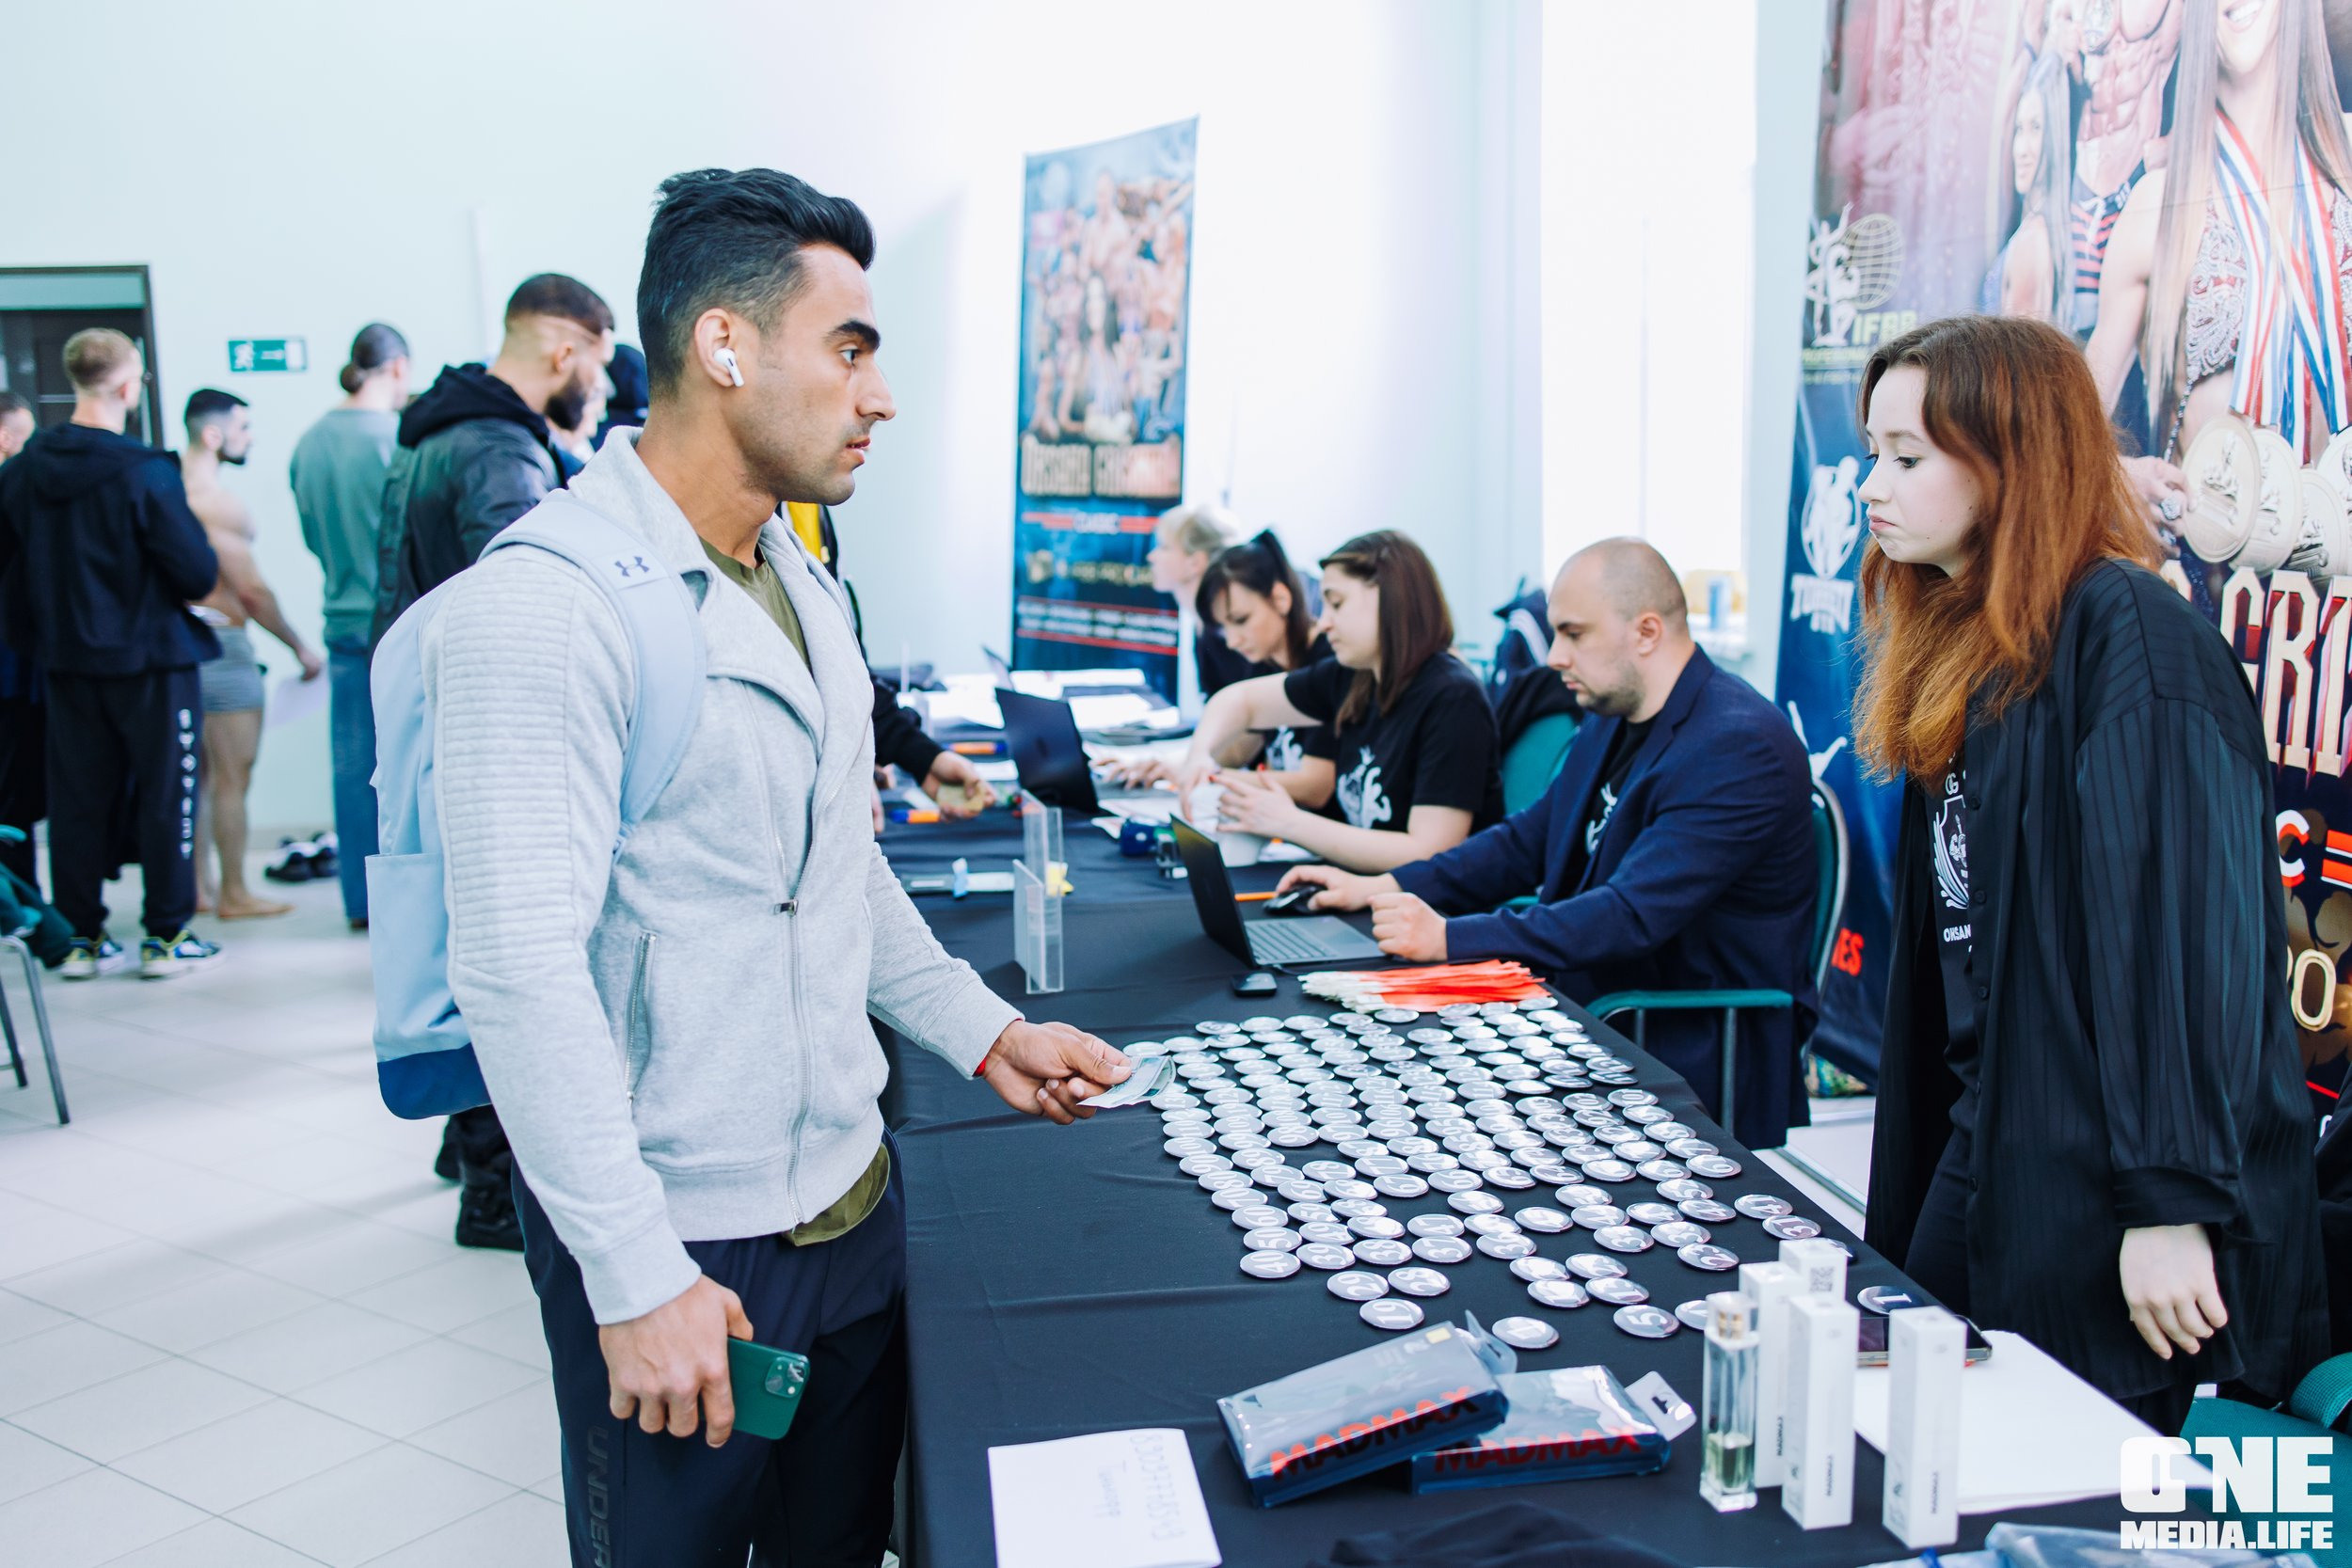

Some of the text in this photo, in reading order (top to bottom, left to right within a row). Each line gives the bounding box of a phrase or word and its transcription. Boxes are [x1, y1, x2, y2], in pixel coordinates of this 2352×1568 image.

[1379, 1103, 1403, 1120] 106
[1174, 1120, 1201, 1137] 110
[1226, 1116, 1252, 1132] 109
[1327, 1124, 1365, 1141] 97
[1380, 1120, 1411, 1137] 96
[1432, 1118, 1465, 1135] 95
[1228, 1132, 1255, 1148] 99
[1279, 1125, 1309, 1144] 98
[1176, 1137, 1206, 1155] 100
[1189, 1155, 1222, 1174] 90
[1241, 1148, 1277, 1167] 89
[1361, 1157, 1402, 1175] 77
[1207, 1171, 1246, 1189] 80
[1262, 1166, 1296, 1183] 79
[1311, 1163, 1348, 1180] 78
[1437, 1170, 1473, 1188] 66
[1290, 1182, 1323, 1199] 69
[1382, 1176, 1411, 1194] 67
[1219, 1188, 1260, 1208] 70
[1746, 1196, 1783, 1214] 41
[1244, 1208, 1279, 1227] 60
[1417, 1218, 1455, 1235] 47
[1308, 1223, 1348, 1241] 49
[1773, 1216, 1820, 1238] 31
[1254, 1229, 1294, 1249] 50
[1482, 1234, 1530, 1255] 36
[1307, 1244, 1347, 1265] 39
[1363, 1240, 1401, 1260] 38
[1422, 1238, 1463, 1259] 37
[1250, 1254, 1288, 1274] 40
[1337, 1275, 1383, 1296] 29
[1394, 1270, 1445, 1292] 28
[1373, 1302, 1414, 1324] 19
[1270, 1386, 1480, 1481] MADMAX
[1434, 1426, 1643, 1473] MADMAX
